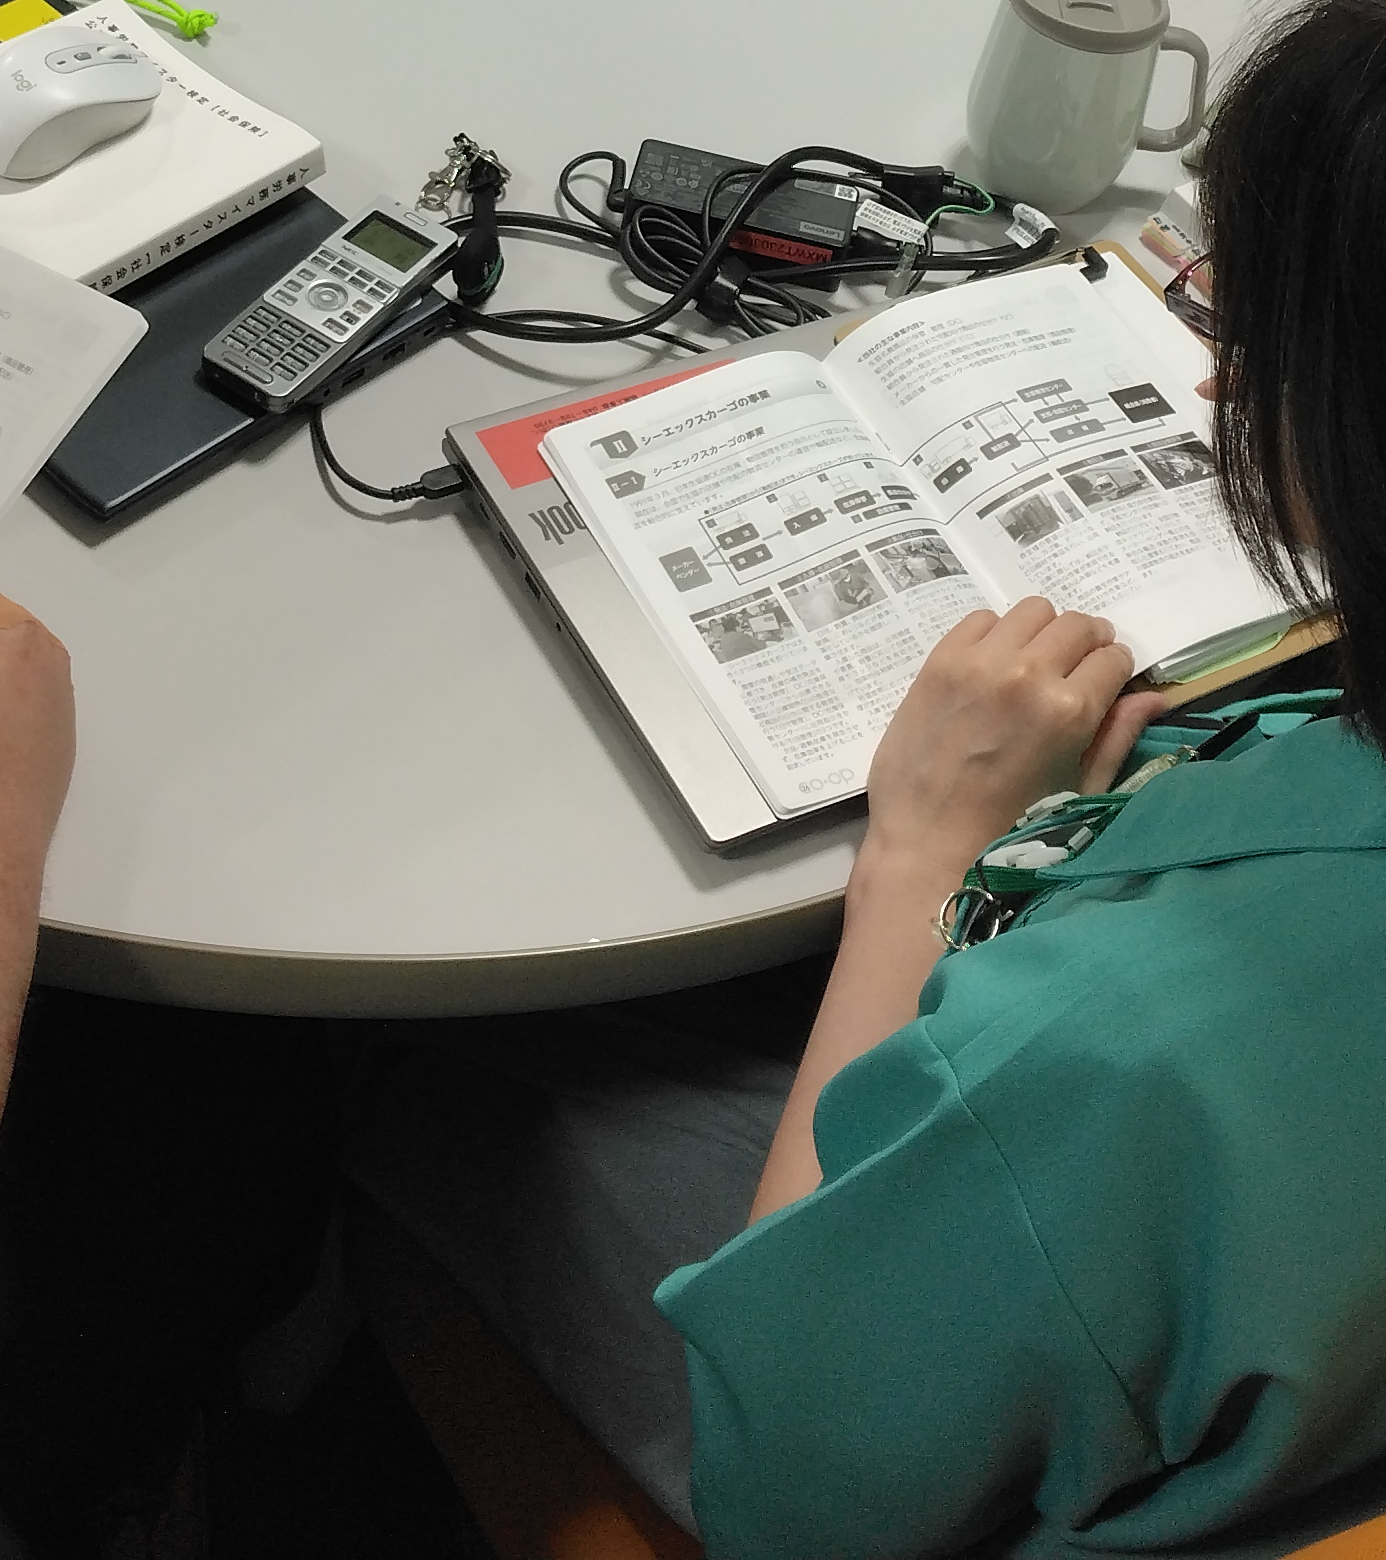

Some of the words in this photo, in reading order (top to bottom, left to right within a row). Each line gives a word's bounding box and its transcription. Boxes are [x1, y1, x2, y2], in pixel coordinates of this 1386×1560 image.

[10, 69, 37, 93] logi
[640, 388, 771, 446] シーエックスカーゴの事業
[652, 426, 766, 477] シーエックスカーゴの事業
